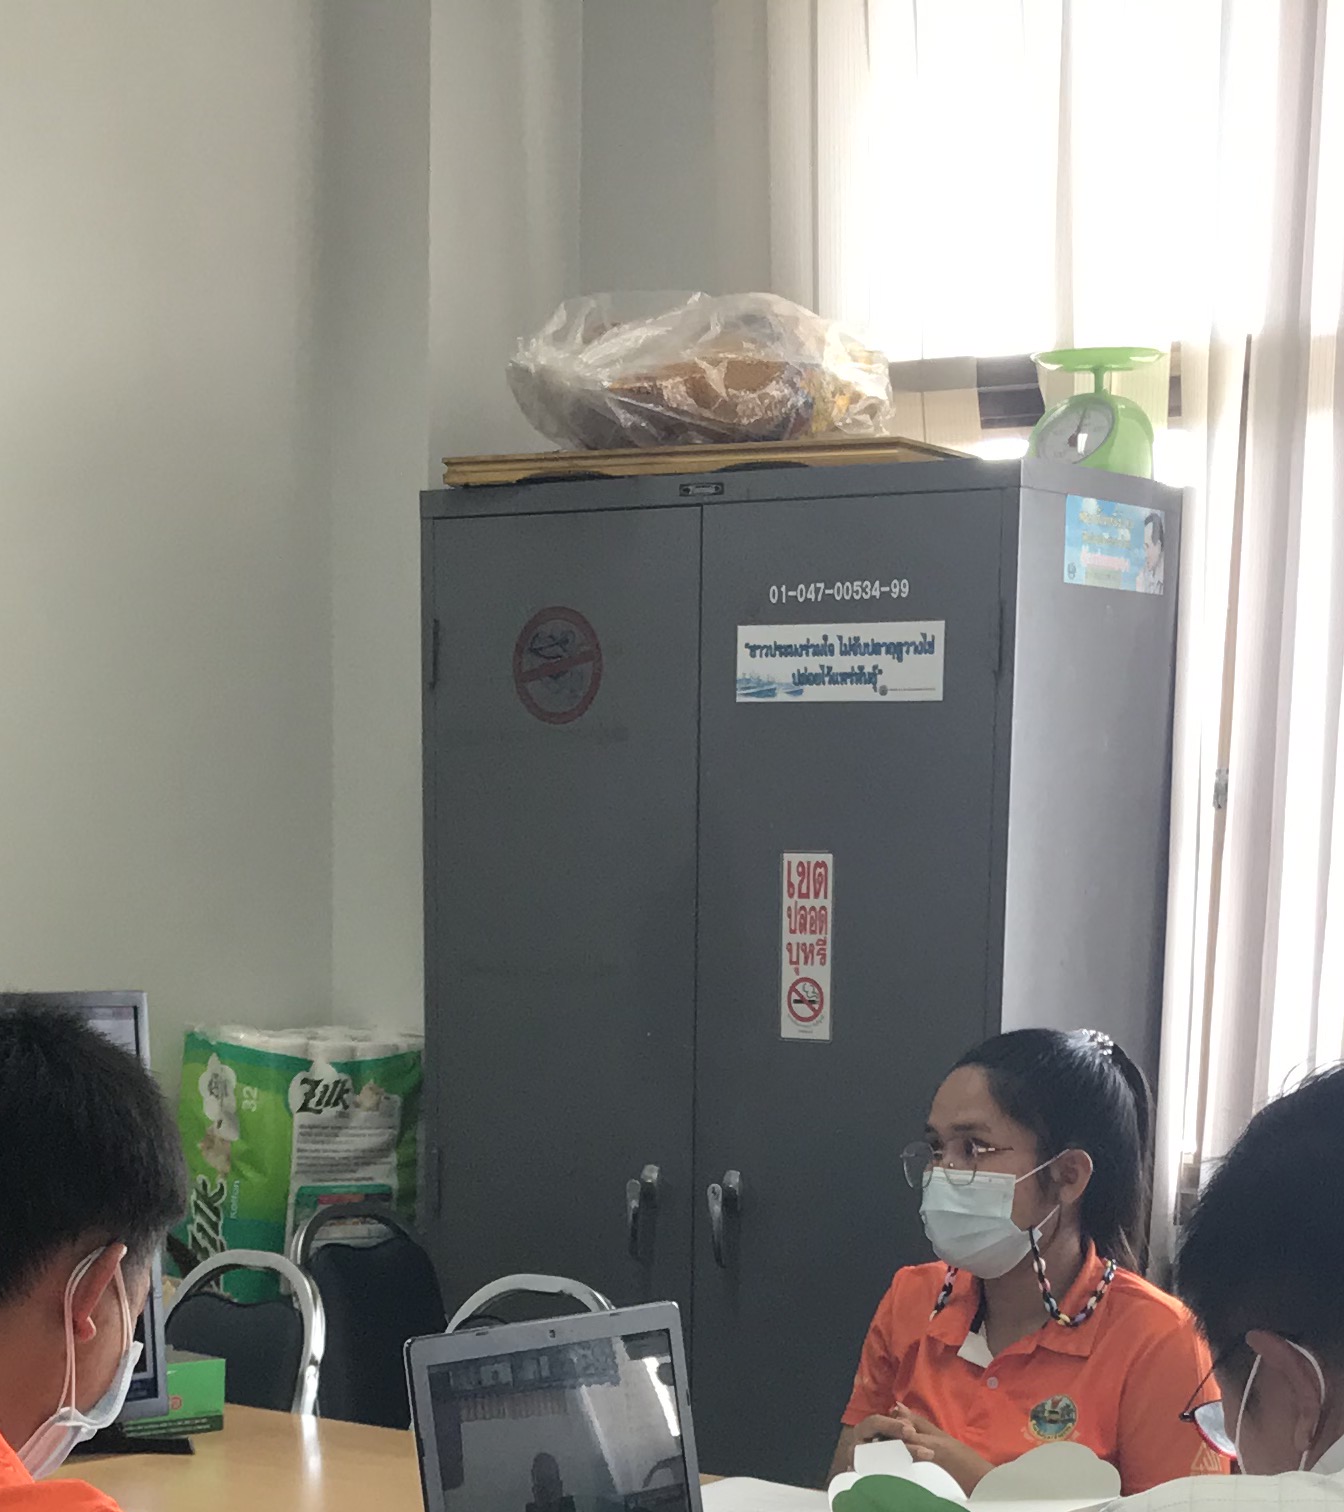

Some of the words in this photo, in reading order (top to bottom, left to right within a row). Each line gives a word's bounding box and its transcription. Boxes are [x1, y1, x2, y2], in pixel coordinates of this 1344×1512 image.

[769, 579, 910, 604] 01-047-00534-99
[787, 860, 828, 900] เขต
[786, 900, 828, 935] ปลอด
[296, 1077, 353, 1115] Zilk
